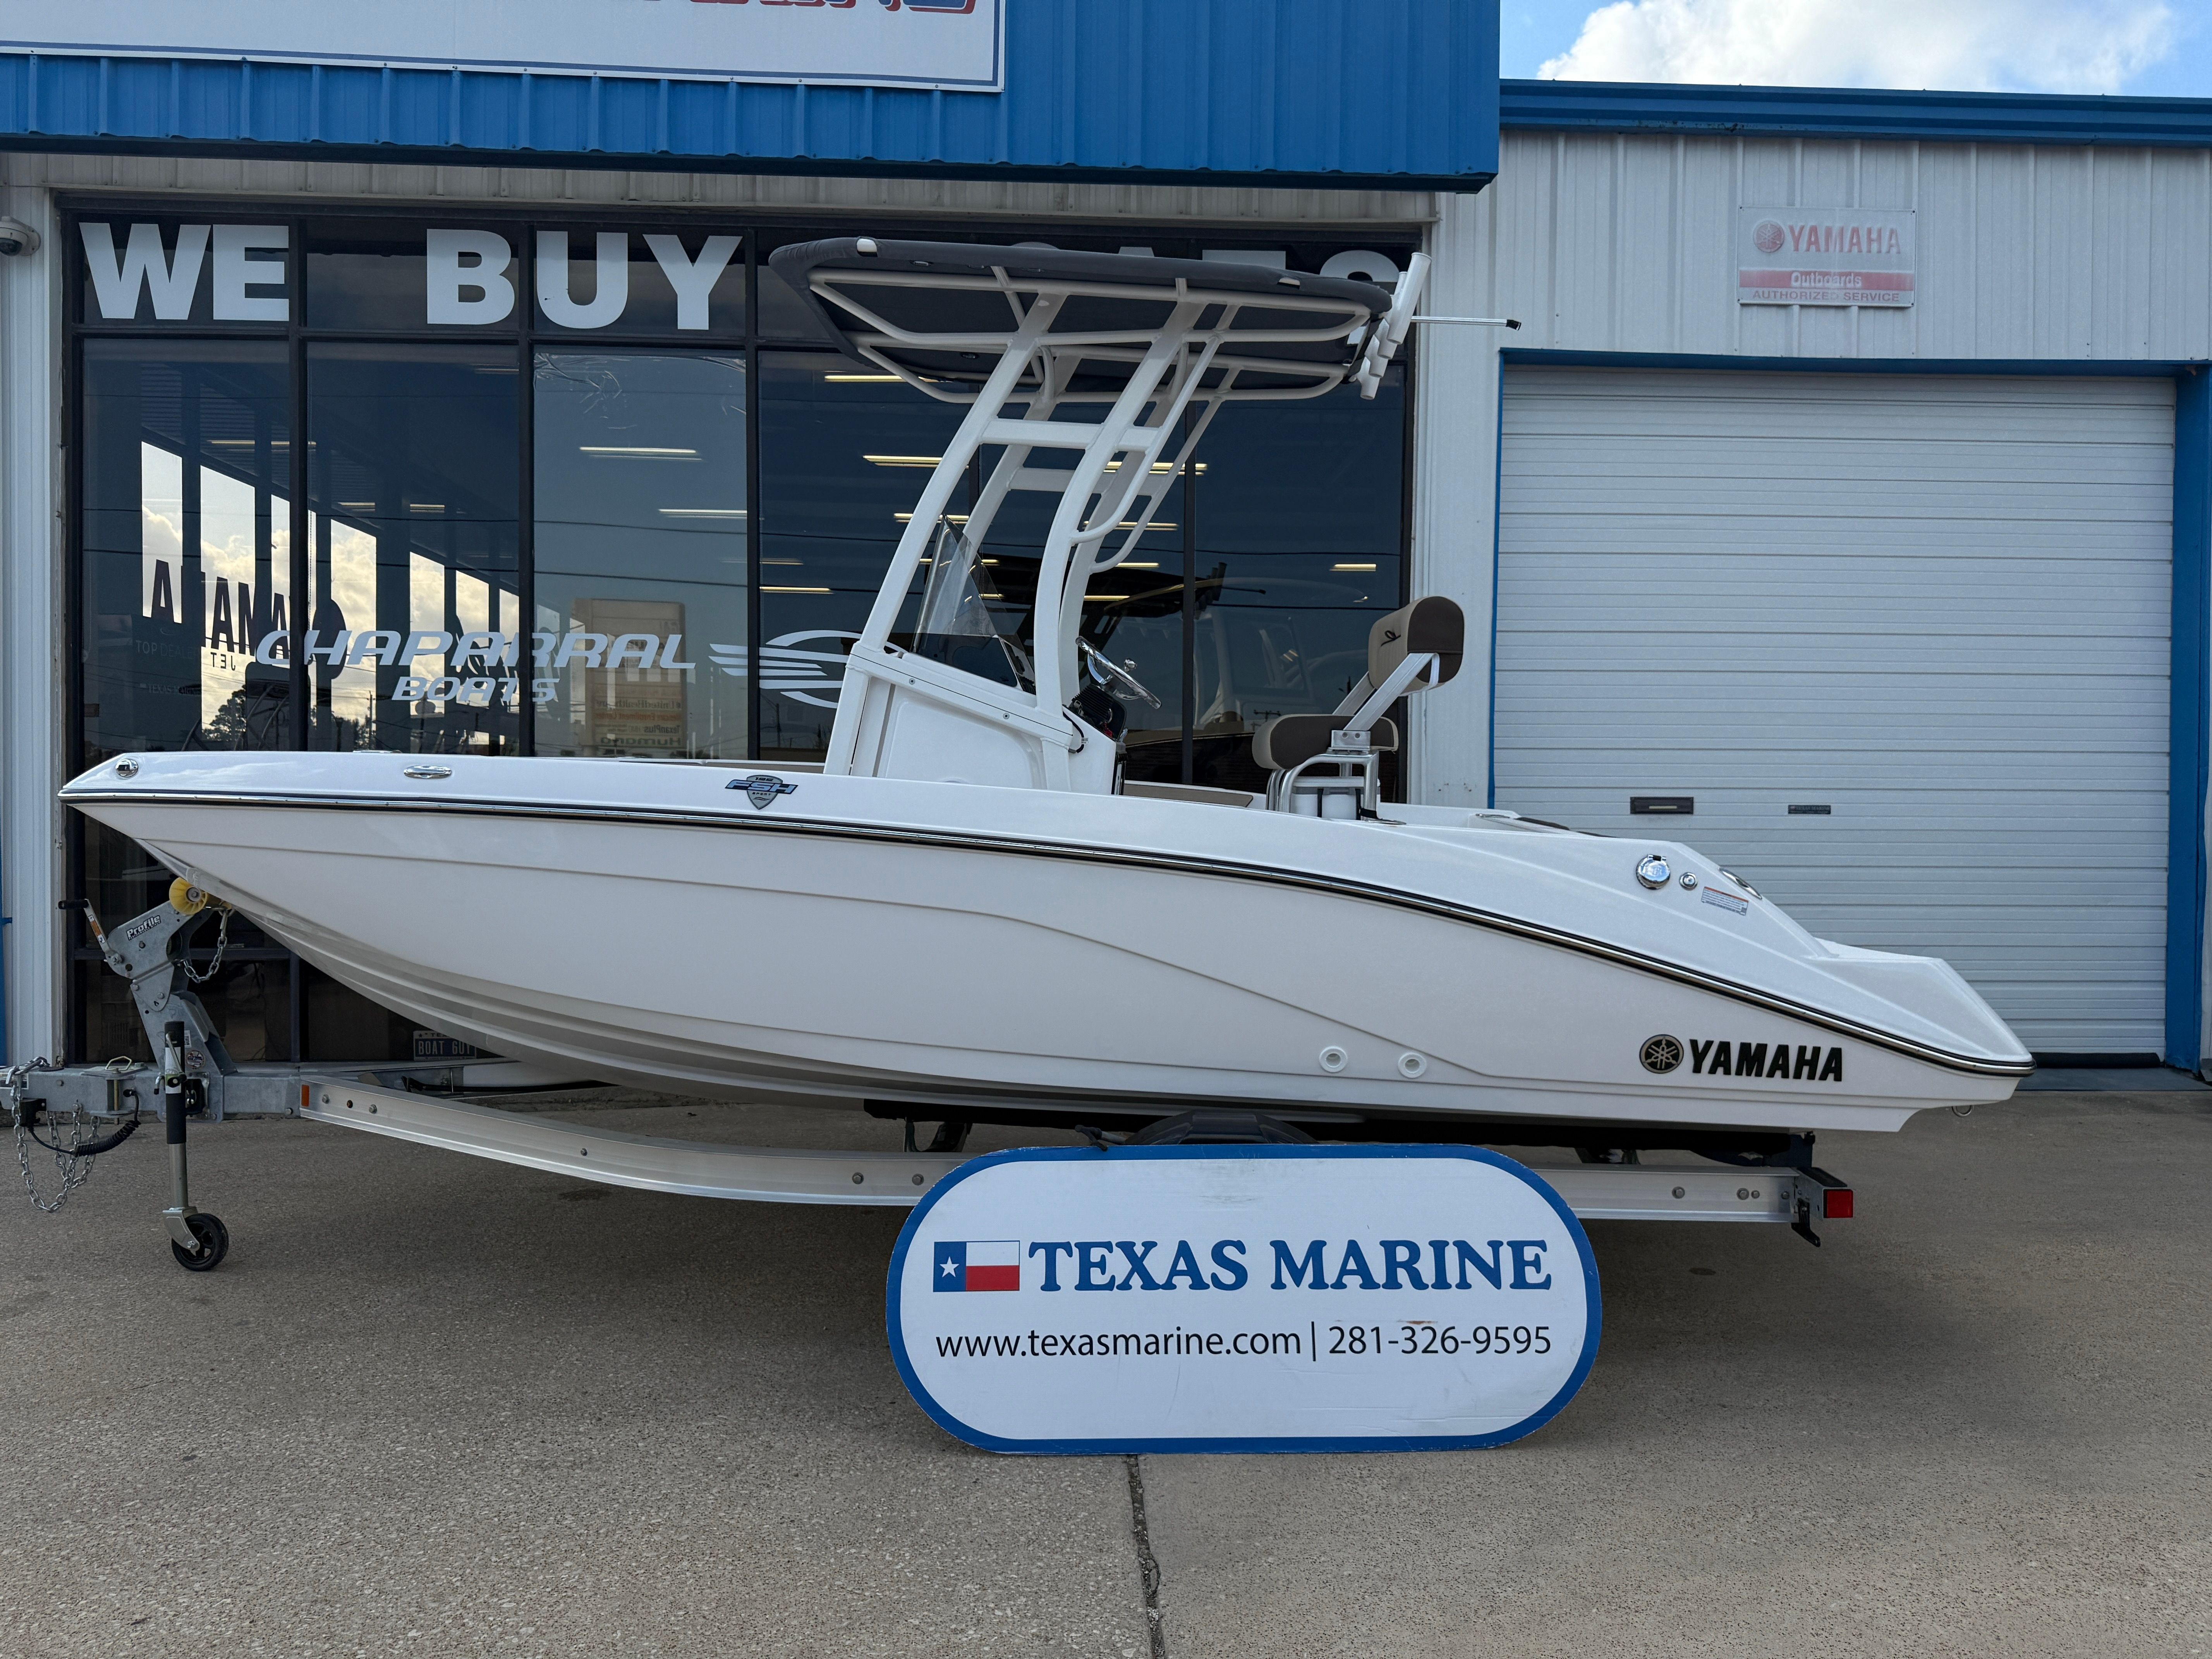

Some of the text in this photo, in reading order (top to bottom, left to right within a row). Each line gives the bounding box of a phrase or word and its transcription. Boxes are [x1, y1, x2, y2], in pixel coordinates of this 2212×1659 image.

[1788, 225, 1901, 254] YAMAHA
[79, 222, 742, 330] WE BUY
[1791, 271, 1862, 287] Outboards
[1753, 290, 1899, 302] AUTHORIZED SERVICE
[136, 639, 157, 654] TOP
[256, 630, 696, 669] CHAPARRAL
[391, 677, 560, 702] BOATS
[727, 780, 796, 793] FSH
[127, 916, 160, 938] Profile
[418, 1041, 470, 1055] BOAT GUY
[1689, 1039, 1842, 1082] YAMAHA
[1028, 1240, 1551, 1291] TEXAS MARINE
[936, 1326, 1300, 1357] www.texasmarine.com
[1329, 1326, 1551, 1354] 281-326-9595
